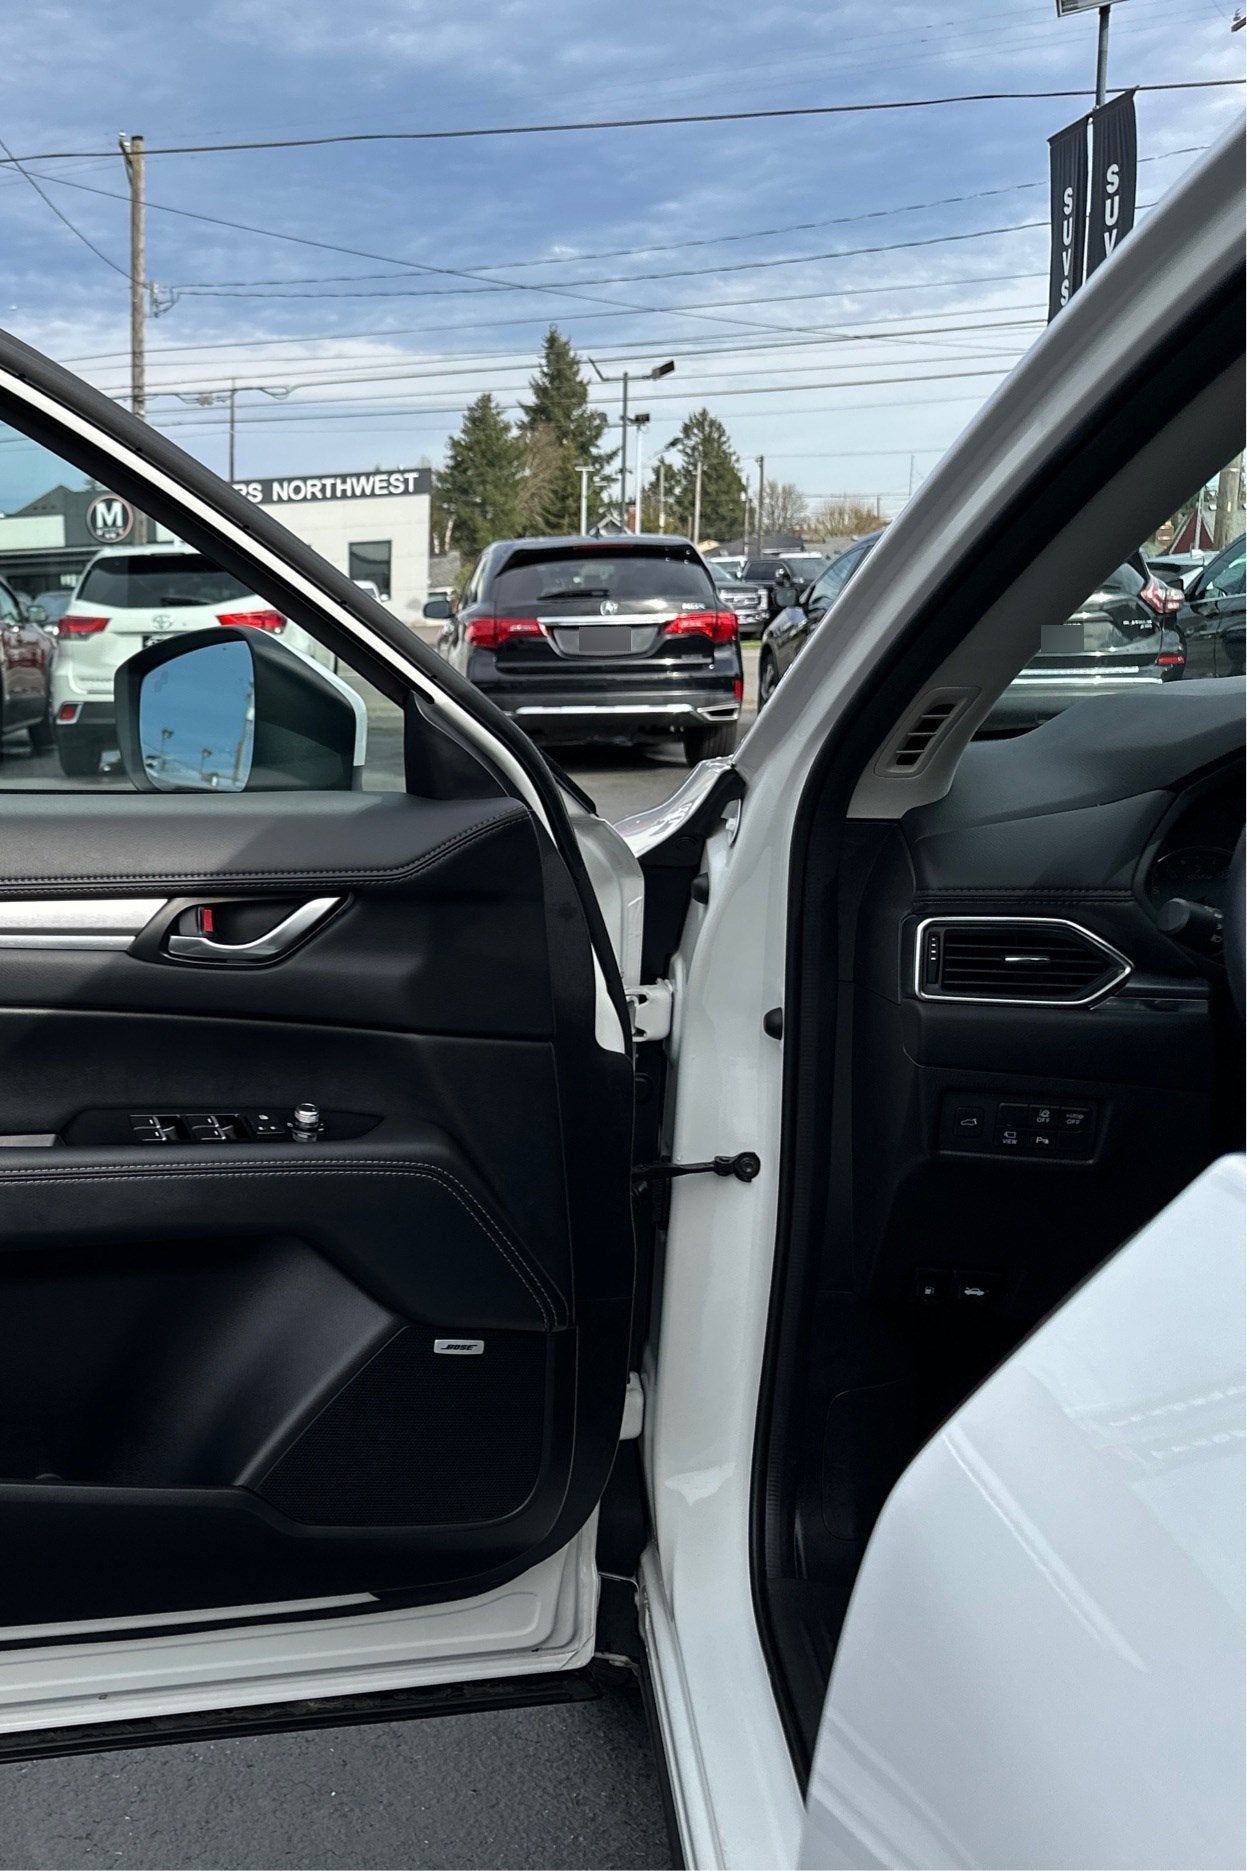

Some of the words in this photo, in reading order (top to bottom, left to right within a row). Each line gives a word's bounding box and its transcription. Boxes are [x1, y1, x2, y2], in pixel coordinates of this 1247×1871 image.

[1060, 186, 1073, 306] SUVS
[272, 471, 420, 502] NORTHWEST
[95, 500, 123, 529] M
